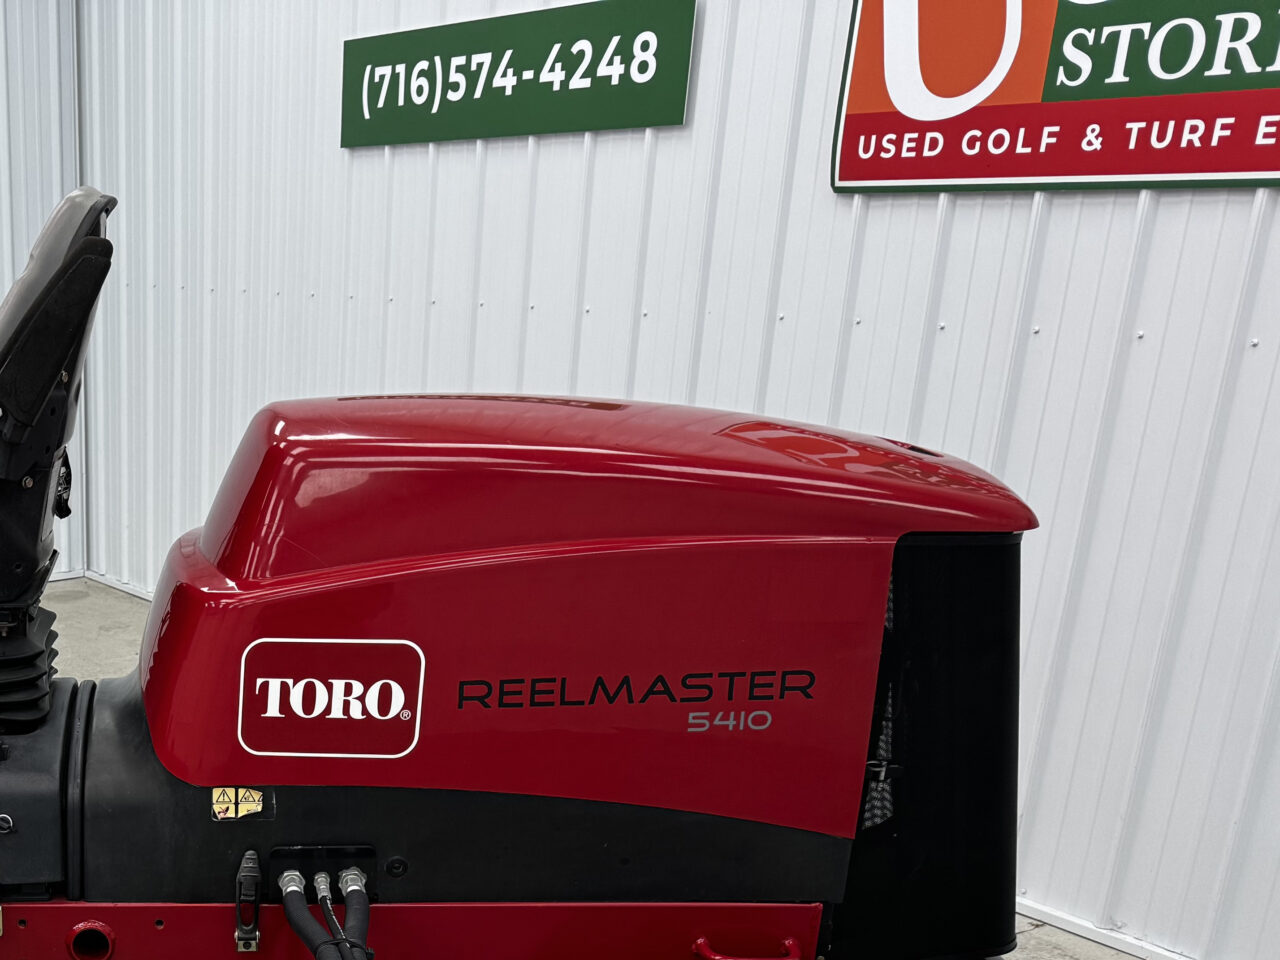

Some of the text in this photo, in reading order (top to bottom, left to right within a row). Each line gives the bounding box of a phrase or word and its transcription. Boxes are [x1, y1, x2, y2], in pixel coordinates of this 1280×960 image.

[1056, 9, 1280, 87] STOR
[362, 30, 658, 120] (716)574-4248
[858, 131, 944, 159] USED
[961, 126, 1061, 156] GOLF
[1080, 124, 1103, 151] &
[1125, 117, 1235, 150] TURF
[457, 670, 816, 709] REELMASTER
[687, 710, 772, 732] 5410
